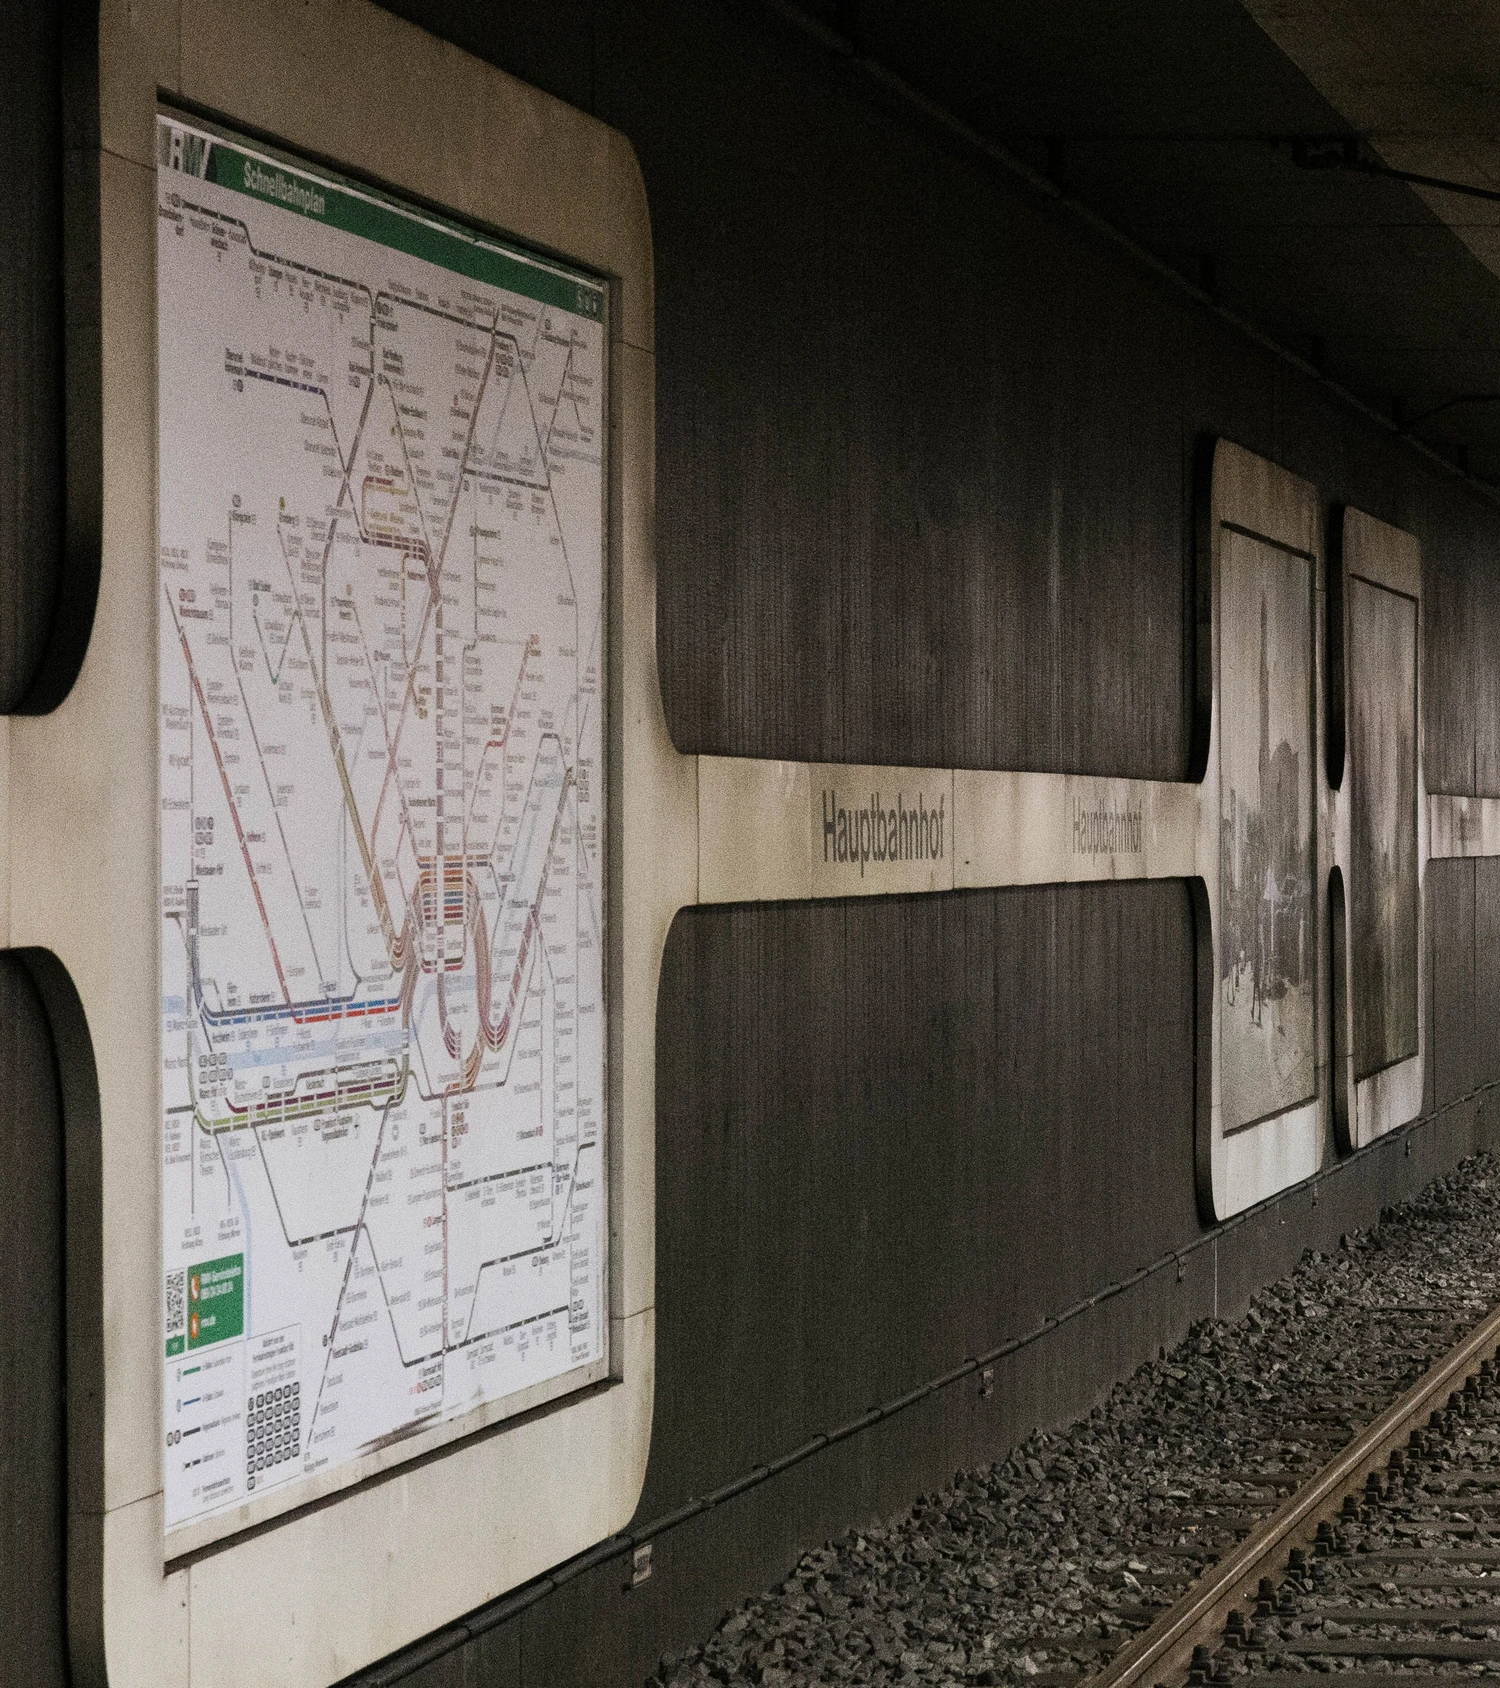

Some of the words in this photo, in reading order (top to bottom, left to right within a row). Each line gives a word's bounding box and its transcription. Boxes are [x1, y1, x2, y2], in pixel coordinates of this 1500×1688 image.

[243, 160, 326, 216] Schnellbahnplan
[822, 789, 946, 878] Hauptbahnhof
[1072, 796, 1142, 867] Hauptbahnhof
